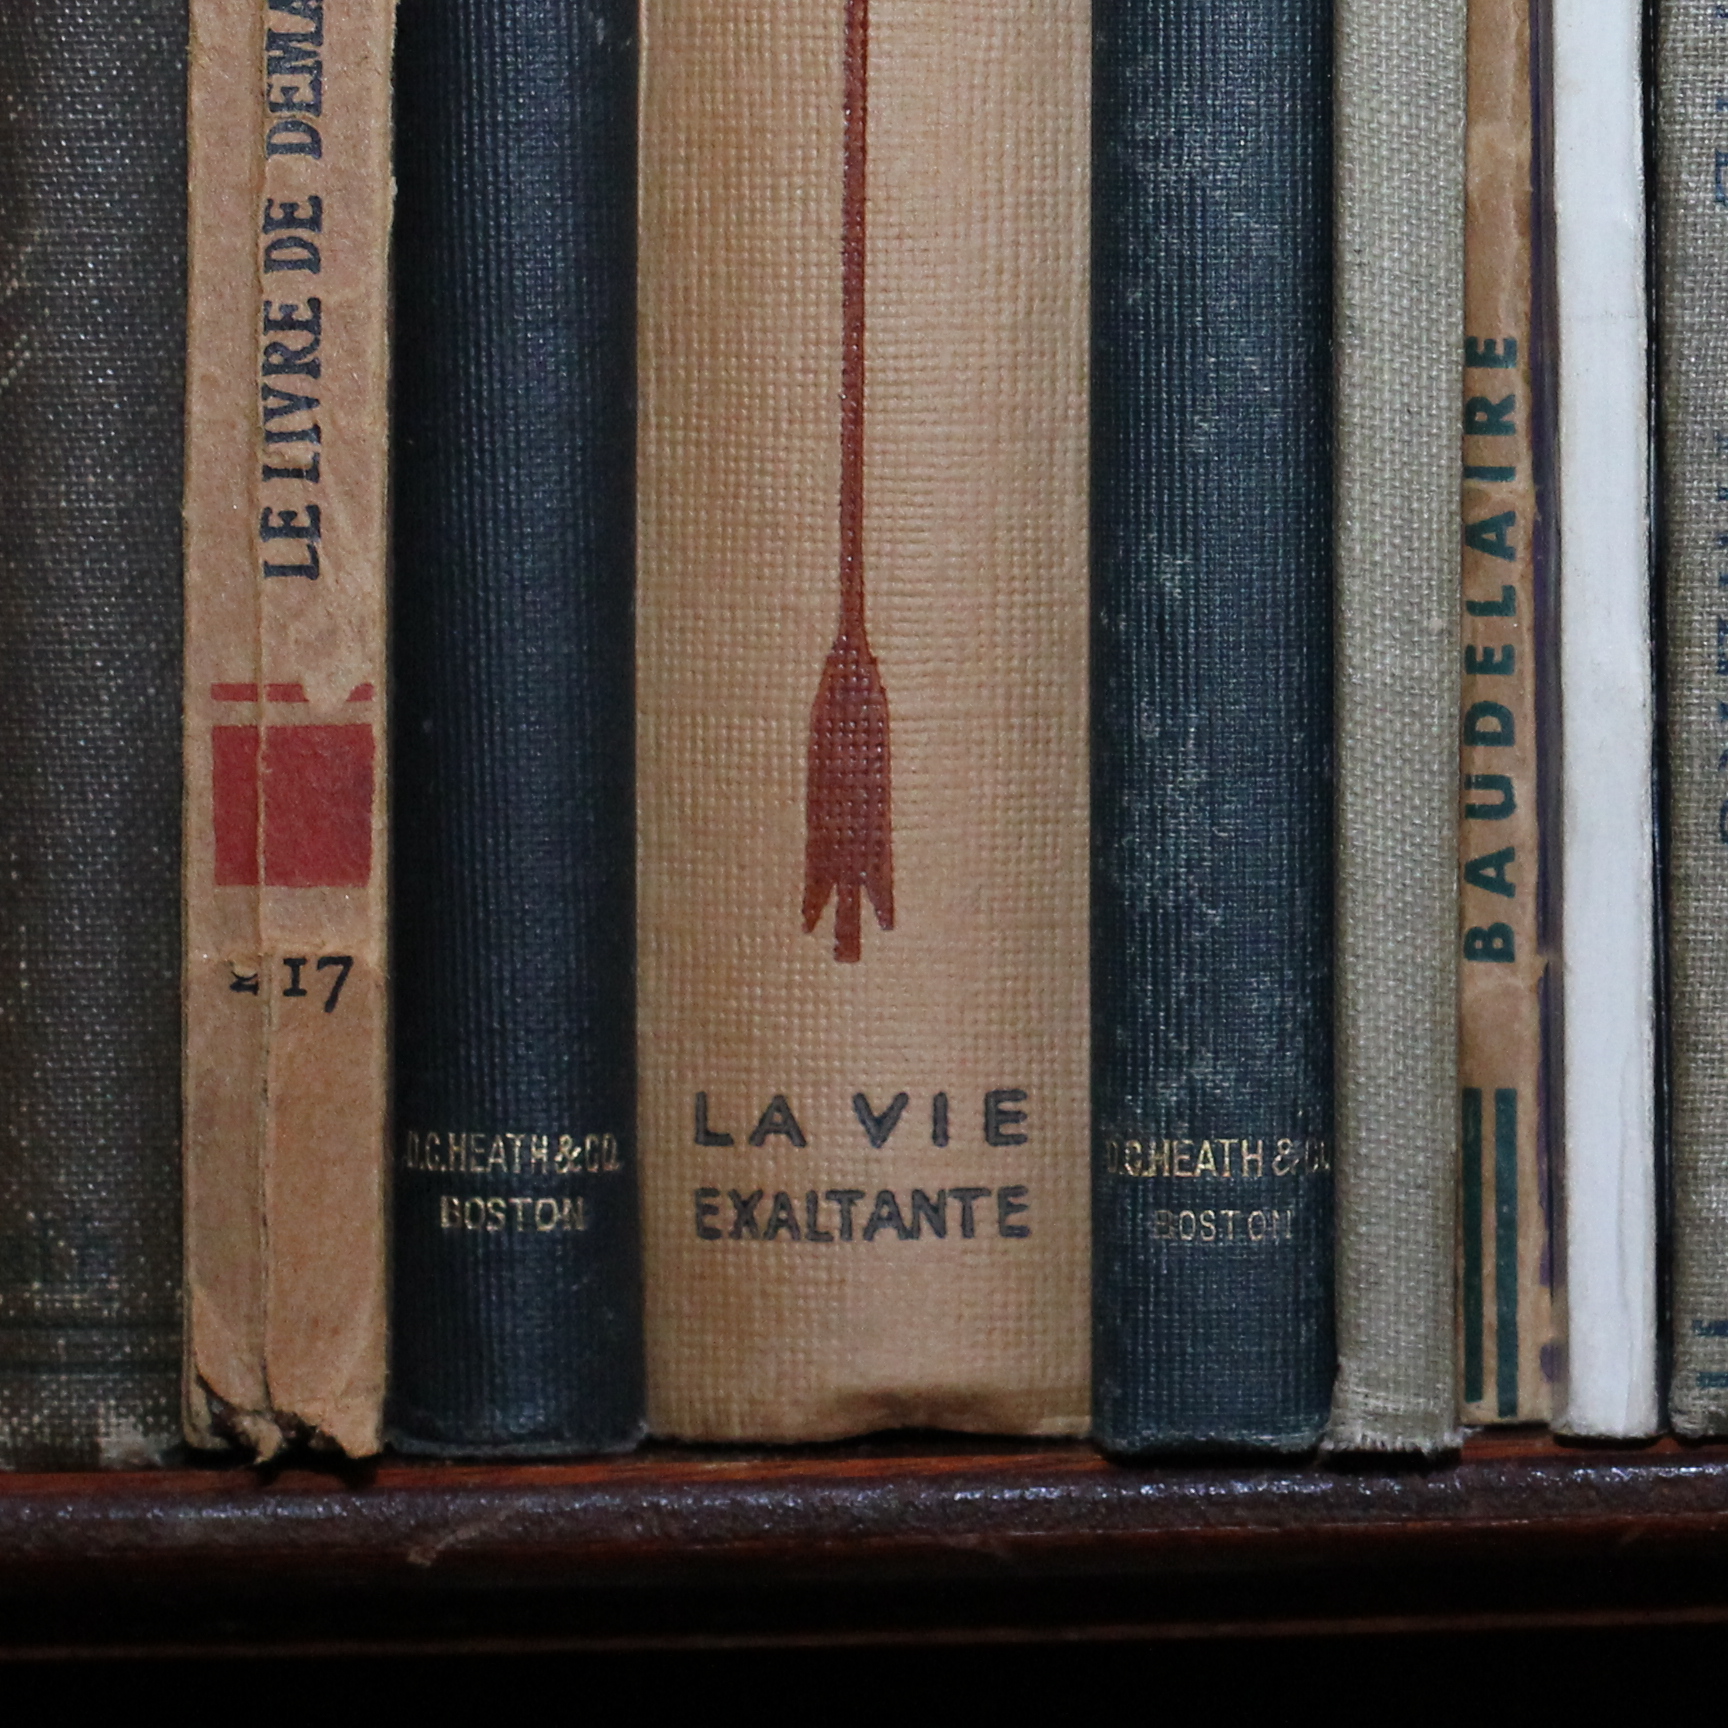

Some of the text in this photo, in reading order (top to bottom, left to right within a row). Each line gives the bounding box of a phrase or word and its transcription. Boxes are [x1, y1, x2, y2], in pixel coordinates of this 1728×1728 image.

[263, 195, 323, 274] DE
[261, 296, 323, 484] LIVRE
[260, 503, 321, 582] LE
[1463, 334, 1518, 964] BAUDELAIRE
[693, 1089, 1030, 1149] LA VIE
[439, 1194, 587, 1233] BOSTON
[694, 1184, 1031, 1242] EXALTANTE
[1152, 1209, 1293, 1242] BOSTON
